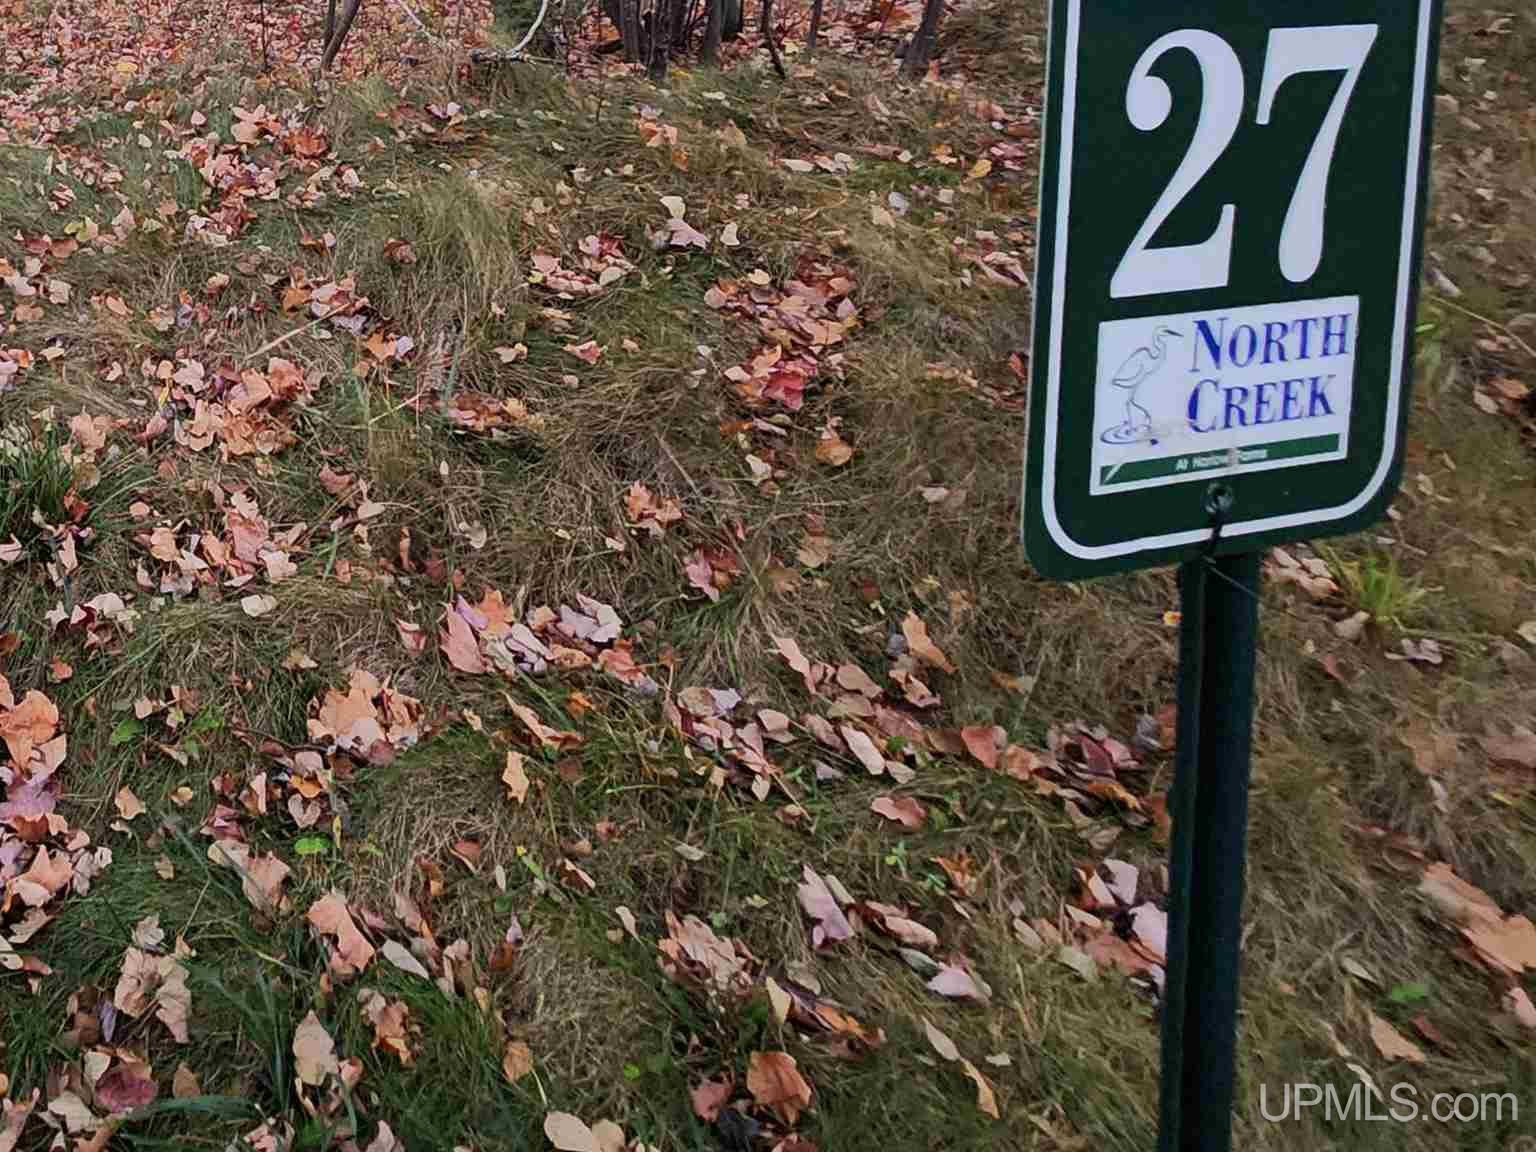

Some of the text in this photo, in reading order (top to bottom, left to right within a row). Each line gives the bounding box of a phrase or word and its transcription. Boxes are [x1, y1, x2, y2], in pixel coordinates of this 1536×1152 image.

[1110, 24, 1379, 298] 27
[1189, 313, 1352, 372] NORTH
[1187, 374, 1336, 433] CREEK
